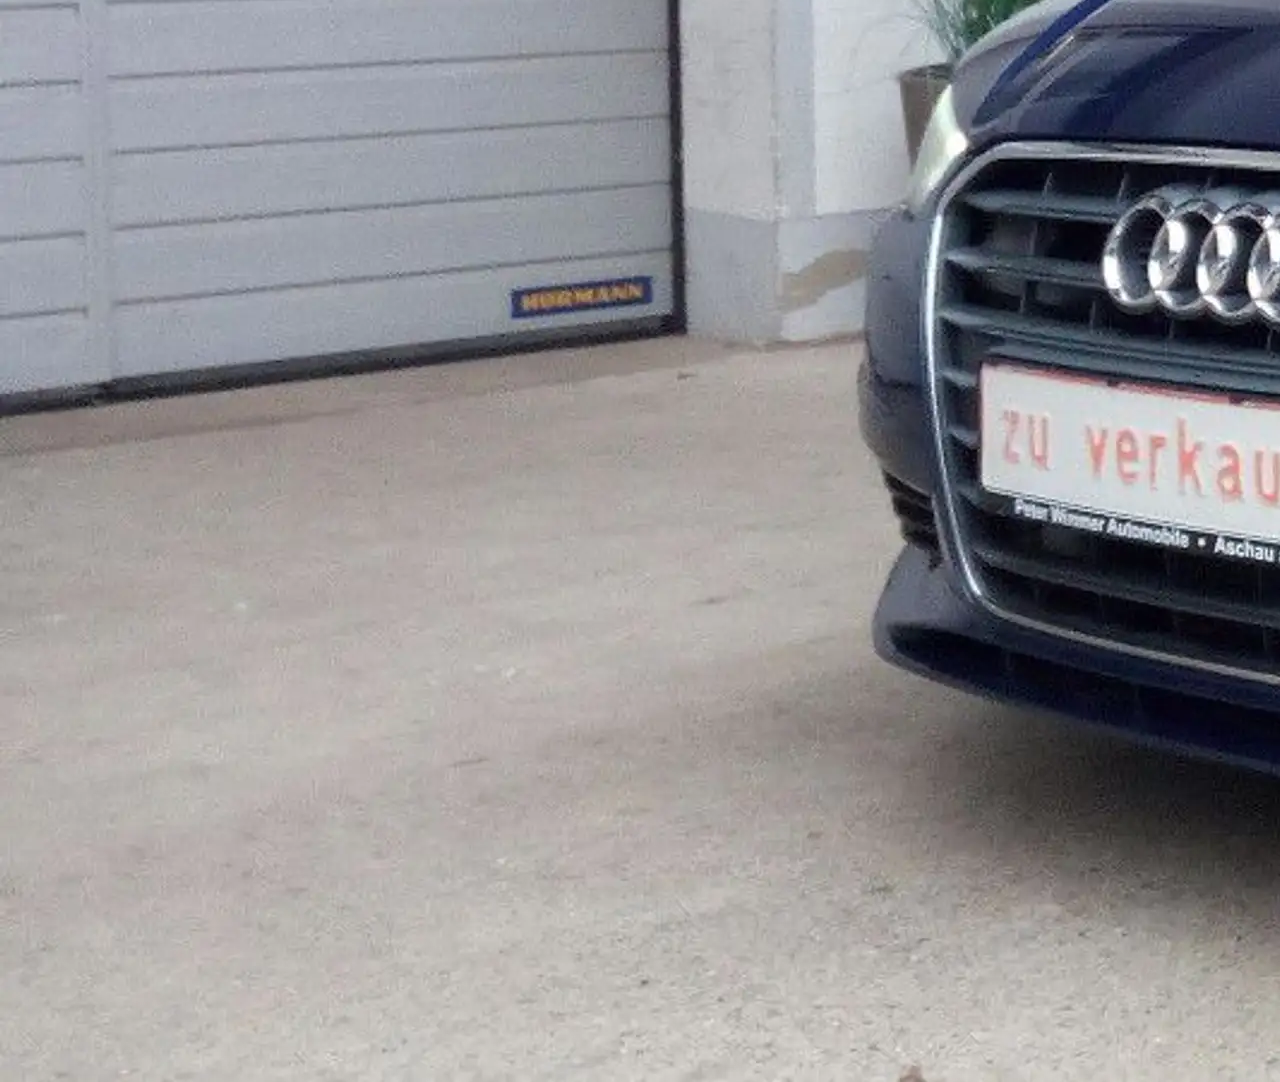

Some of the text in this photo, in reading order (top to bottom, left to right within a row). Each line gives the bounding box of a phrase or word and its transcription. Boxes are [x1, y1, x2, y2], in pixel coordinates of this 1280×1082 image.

[1000, 408, 1052, 471] zu
[1106, 518, 1190, 550] Automobile
[1214, 535, 1275, 564] Aschau
